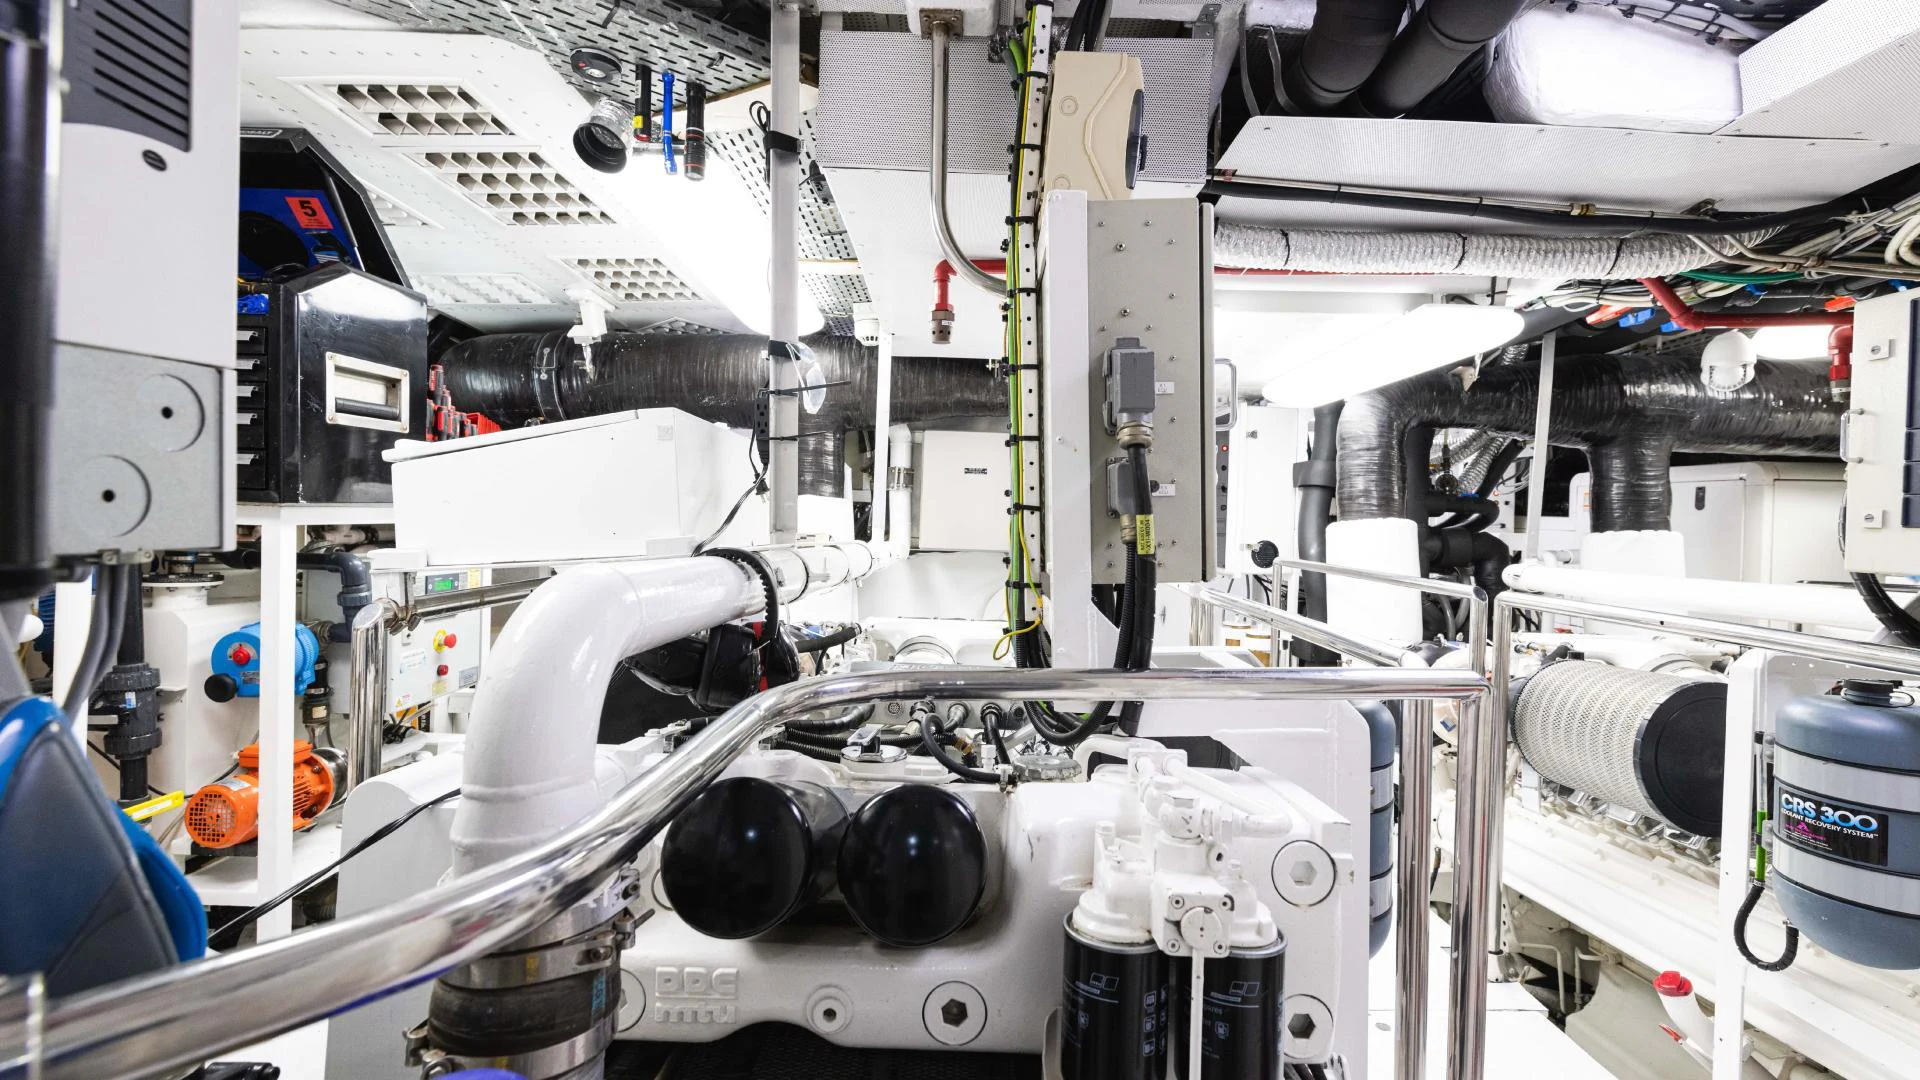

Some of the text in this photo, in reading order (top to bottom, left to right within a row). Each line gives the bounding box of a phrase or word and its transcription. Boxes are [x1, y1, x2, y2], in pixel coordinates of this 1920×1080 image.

[299, 200, 317, 217] 5
[1781, 793, 1817, 819] CRS
[1820, 806, 1878, 832] 300
[1805, 817, 1841, 832] RECOVERY
[655, 966, 739, 994] DDC
